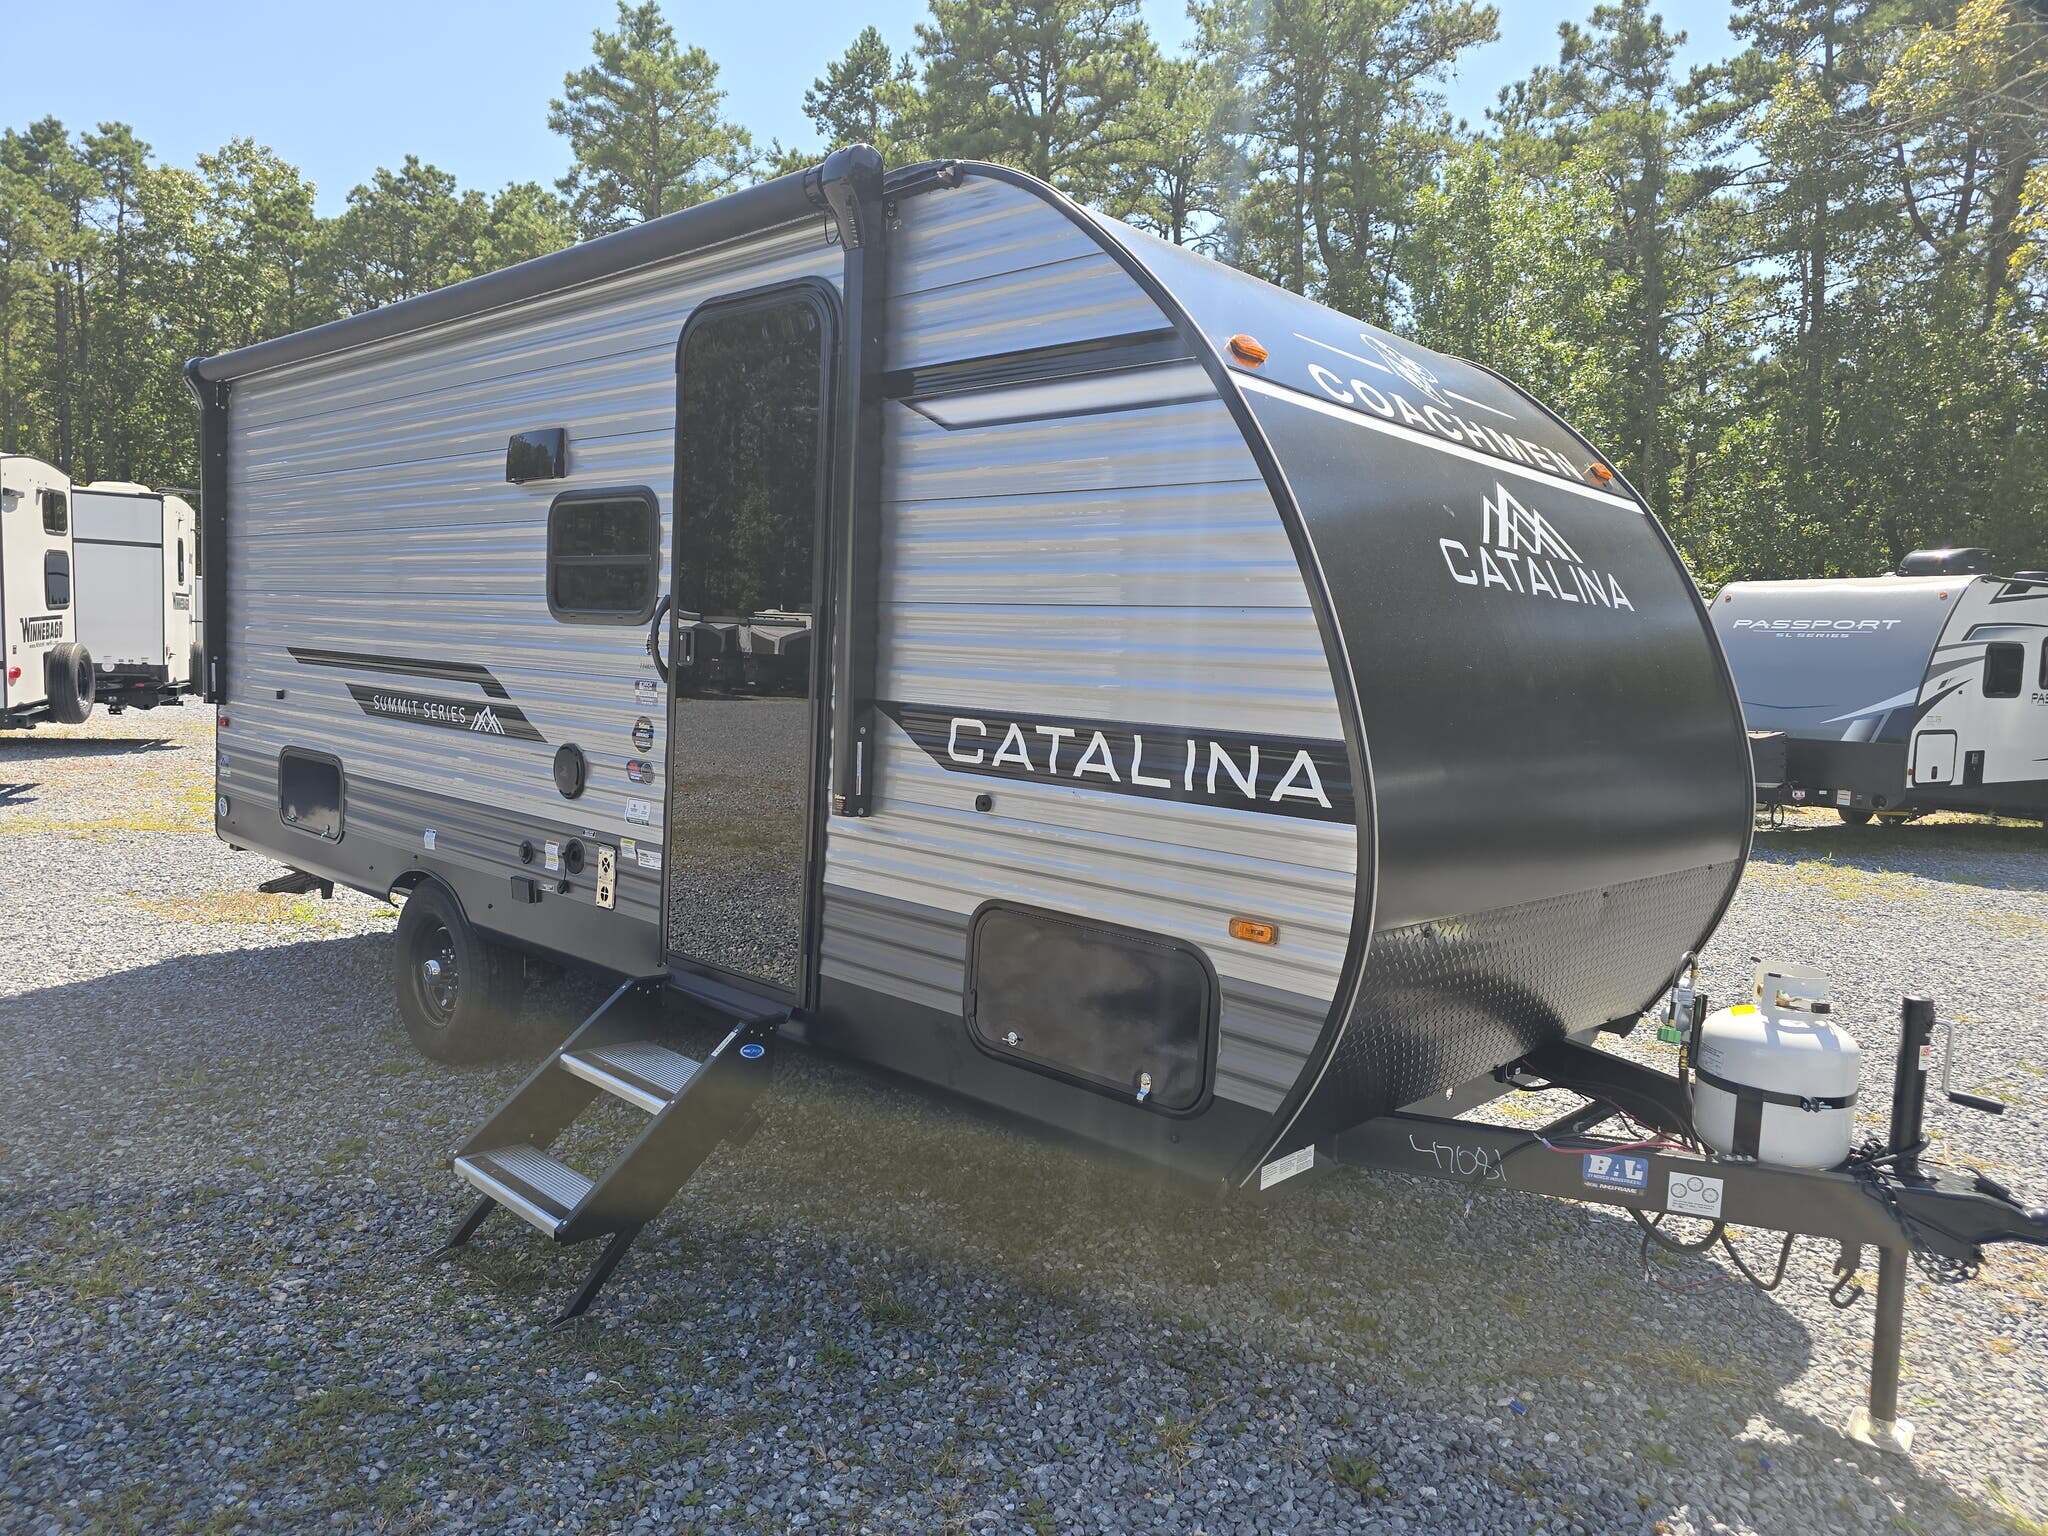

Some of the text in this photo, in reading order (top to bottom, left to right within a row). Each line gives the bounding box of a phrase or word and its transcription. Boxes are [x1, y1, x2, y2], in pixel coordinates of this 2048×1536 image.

[1307, 363, 1586, 480] COACHMEN
[1439, 537, 1635, 612] CATALINA
[20, 615, 64, 643] WINNEBAGO
[1732, 619, 1902, 630] PASSPORT
[373, 694, 466, 724] SUMMIT SERIES
[947, 717, 1332, 808] CATALINA
